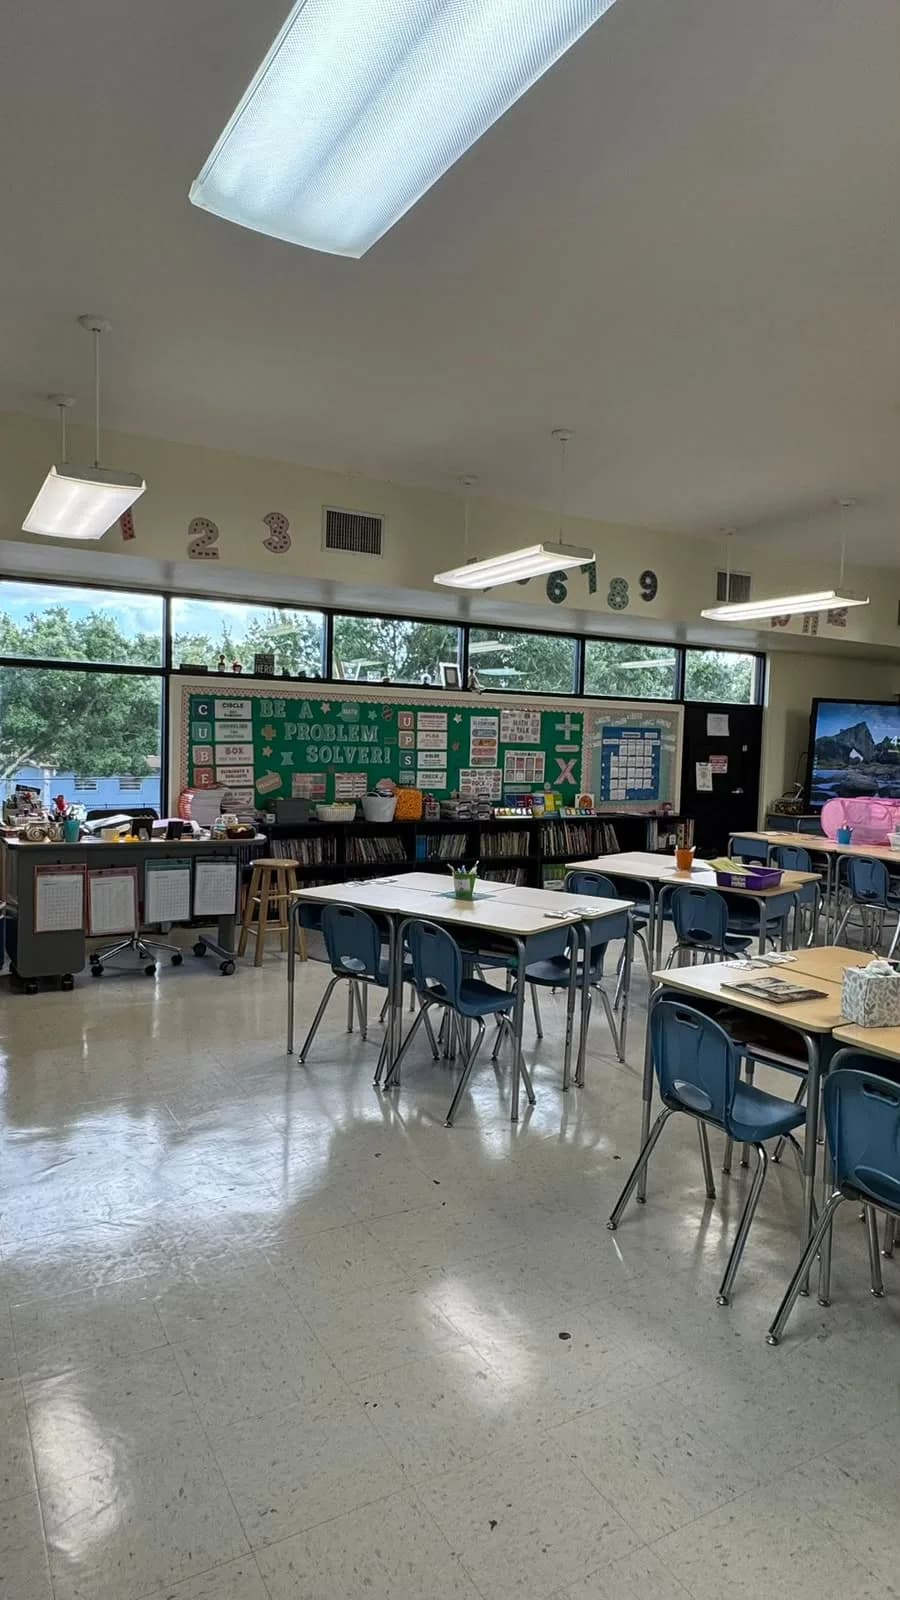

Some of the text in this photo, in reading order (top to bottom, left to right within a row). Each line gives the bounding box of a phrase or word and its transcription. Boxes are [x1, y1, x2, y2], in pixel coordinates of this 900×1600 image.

[187, 517, 220, 560] 2
[262, 512, 292, 554] 3
[546, 570, 568, 604] 6
[607, 577, 629, 611] 8
[639, 569, 658, 602] 9
[198, 704, 208, 716] C
[259, 699, 286, 719] BE
[298, 701, 314, 719] A
[403, 717, 411, 727] U
[198, 727, 208, 739] U
[284, 722, 379, 743] PROBLEM
[405, 736, 412, 745] P
[200, 751, 209, 762] B
[306, 745, 391, 765] SOLVER!
[404, 755, 412, 766] S
[201, 773, 209, 784] E
